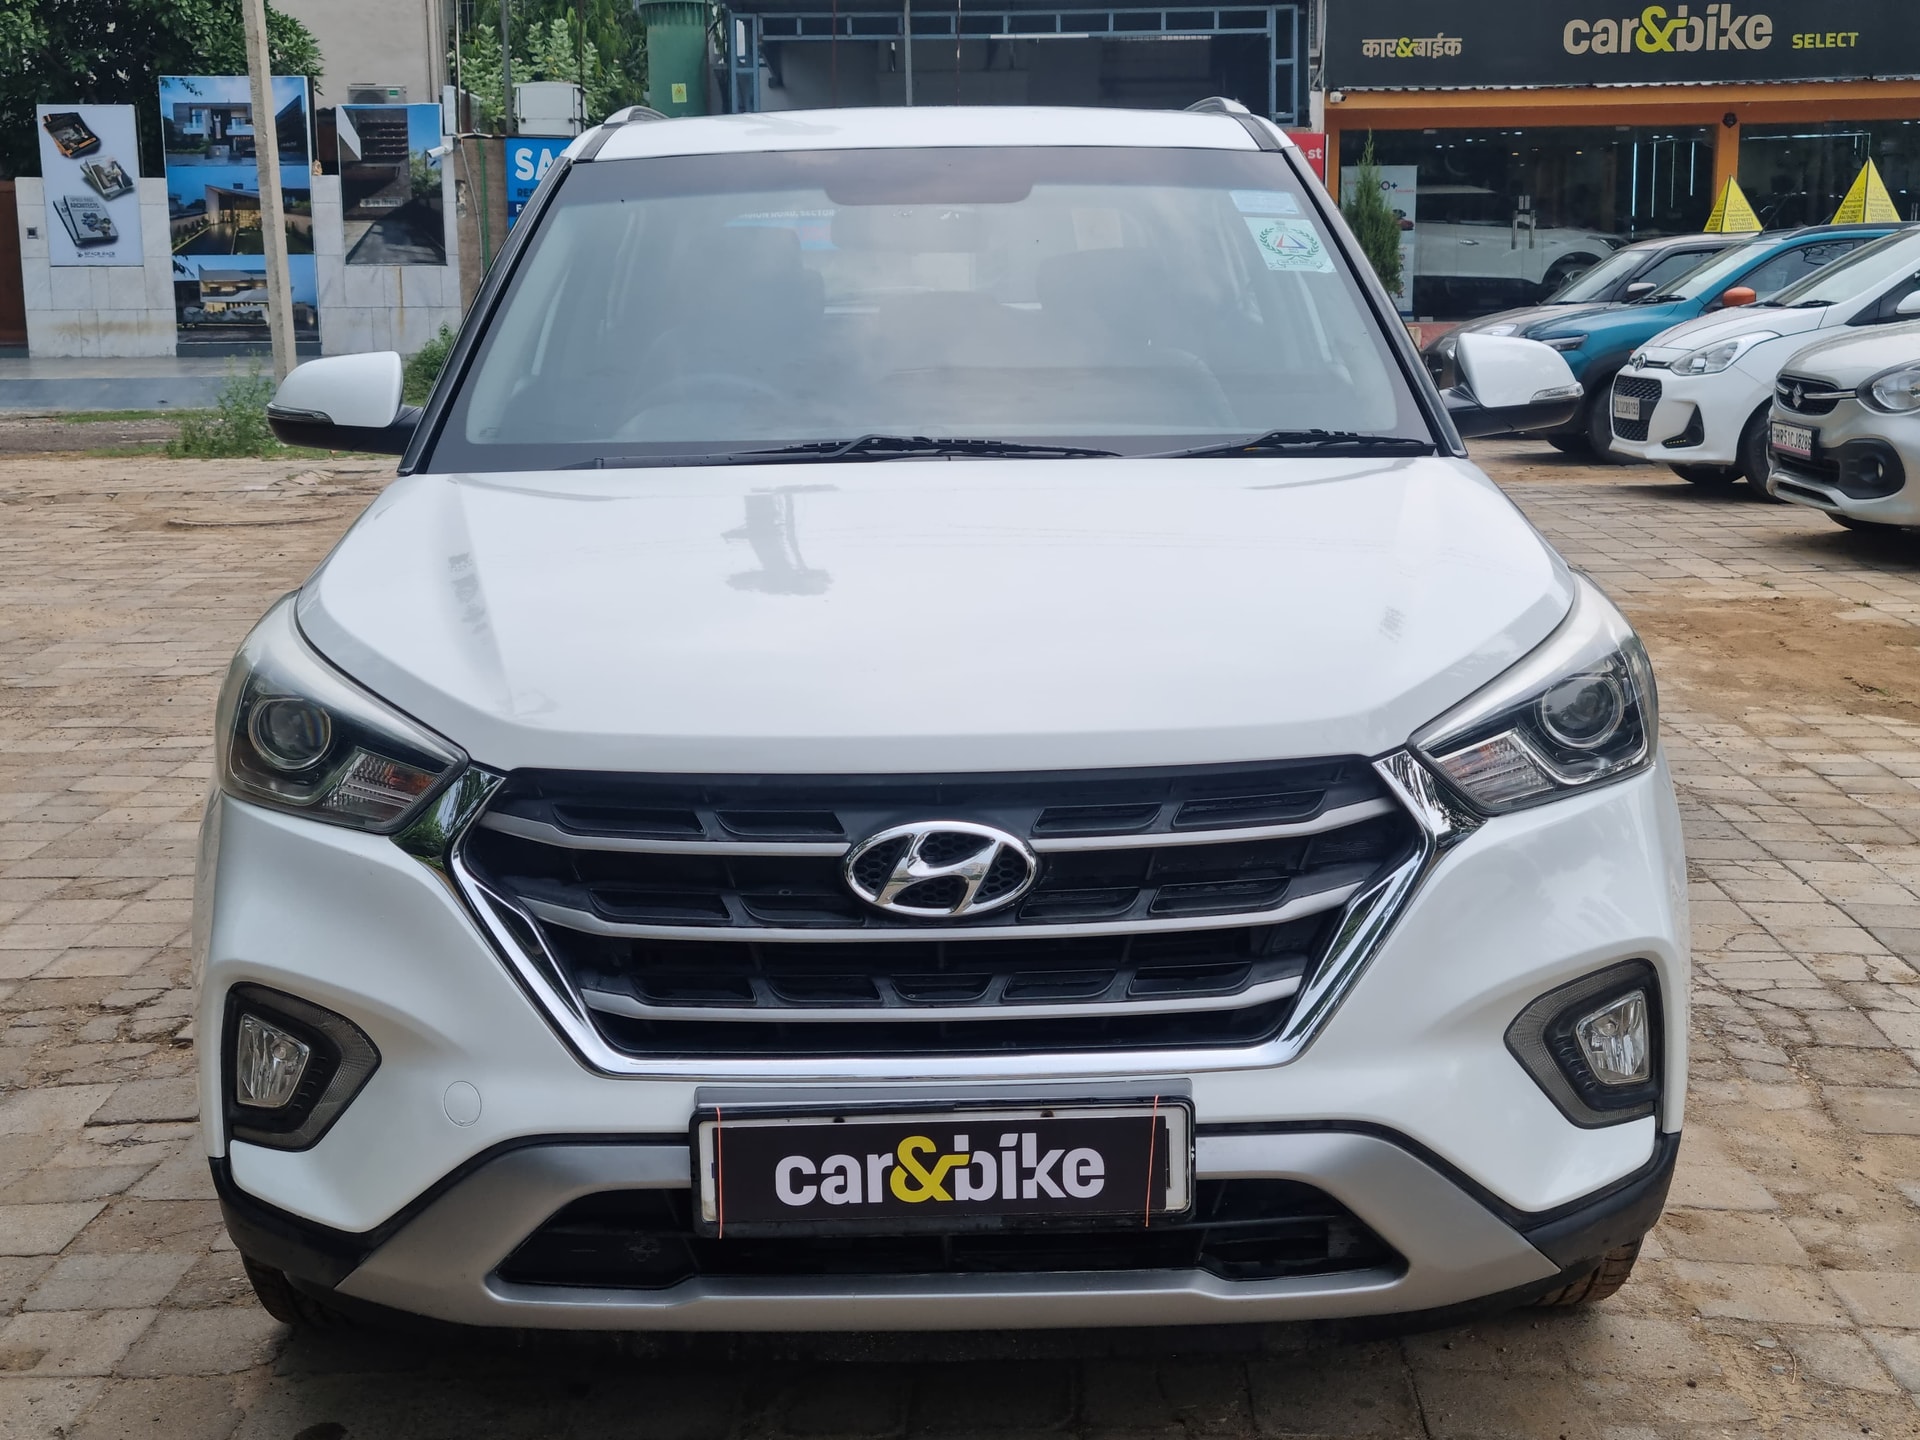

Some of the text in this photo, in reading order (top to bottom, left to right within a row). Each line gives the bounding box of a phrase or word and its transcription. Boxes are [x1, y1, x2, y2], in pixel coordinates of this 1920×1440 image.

[1361, 32, 1463, 59] कार&बाईक
[1563, 3, 1859, 55] car&bike SELECT
[515, 147, 566, 181] SA
[774, 1132, 1106, 1207] car&bike
